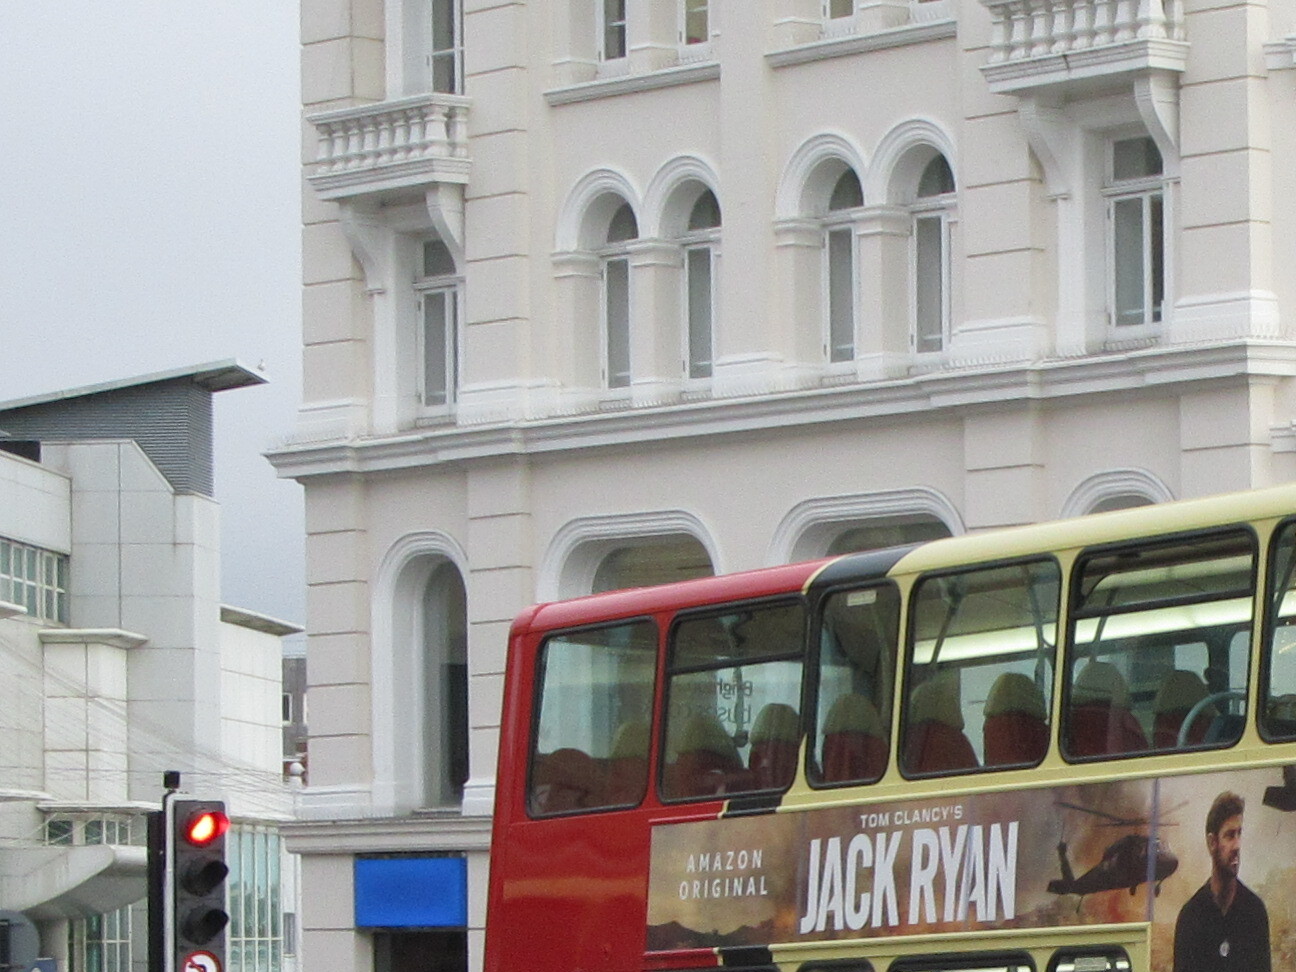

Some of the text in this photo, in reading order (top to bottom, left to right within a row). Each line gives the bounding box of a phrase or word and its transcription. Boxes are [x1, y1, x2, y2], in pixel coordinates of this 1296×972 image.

[860, 805, 963, 828] TOM CLANCY'S
[686, 849, 762, 873] AMAZON
[679, 875, 768, 900] ORIGINAL
[800, 821, 1019, 935] JACK RYAN
